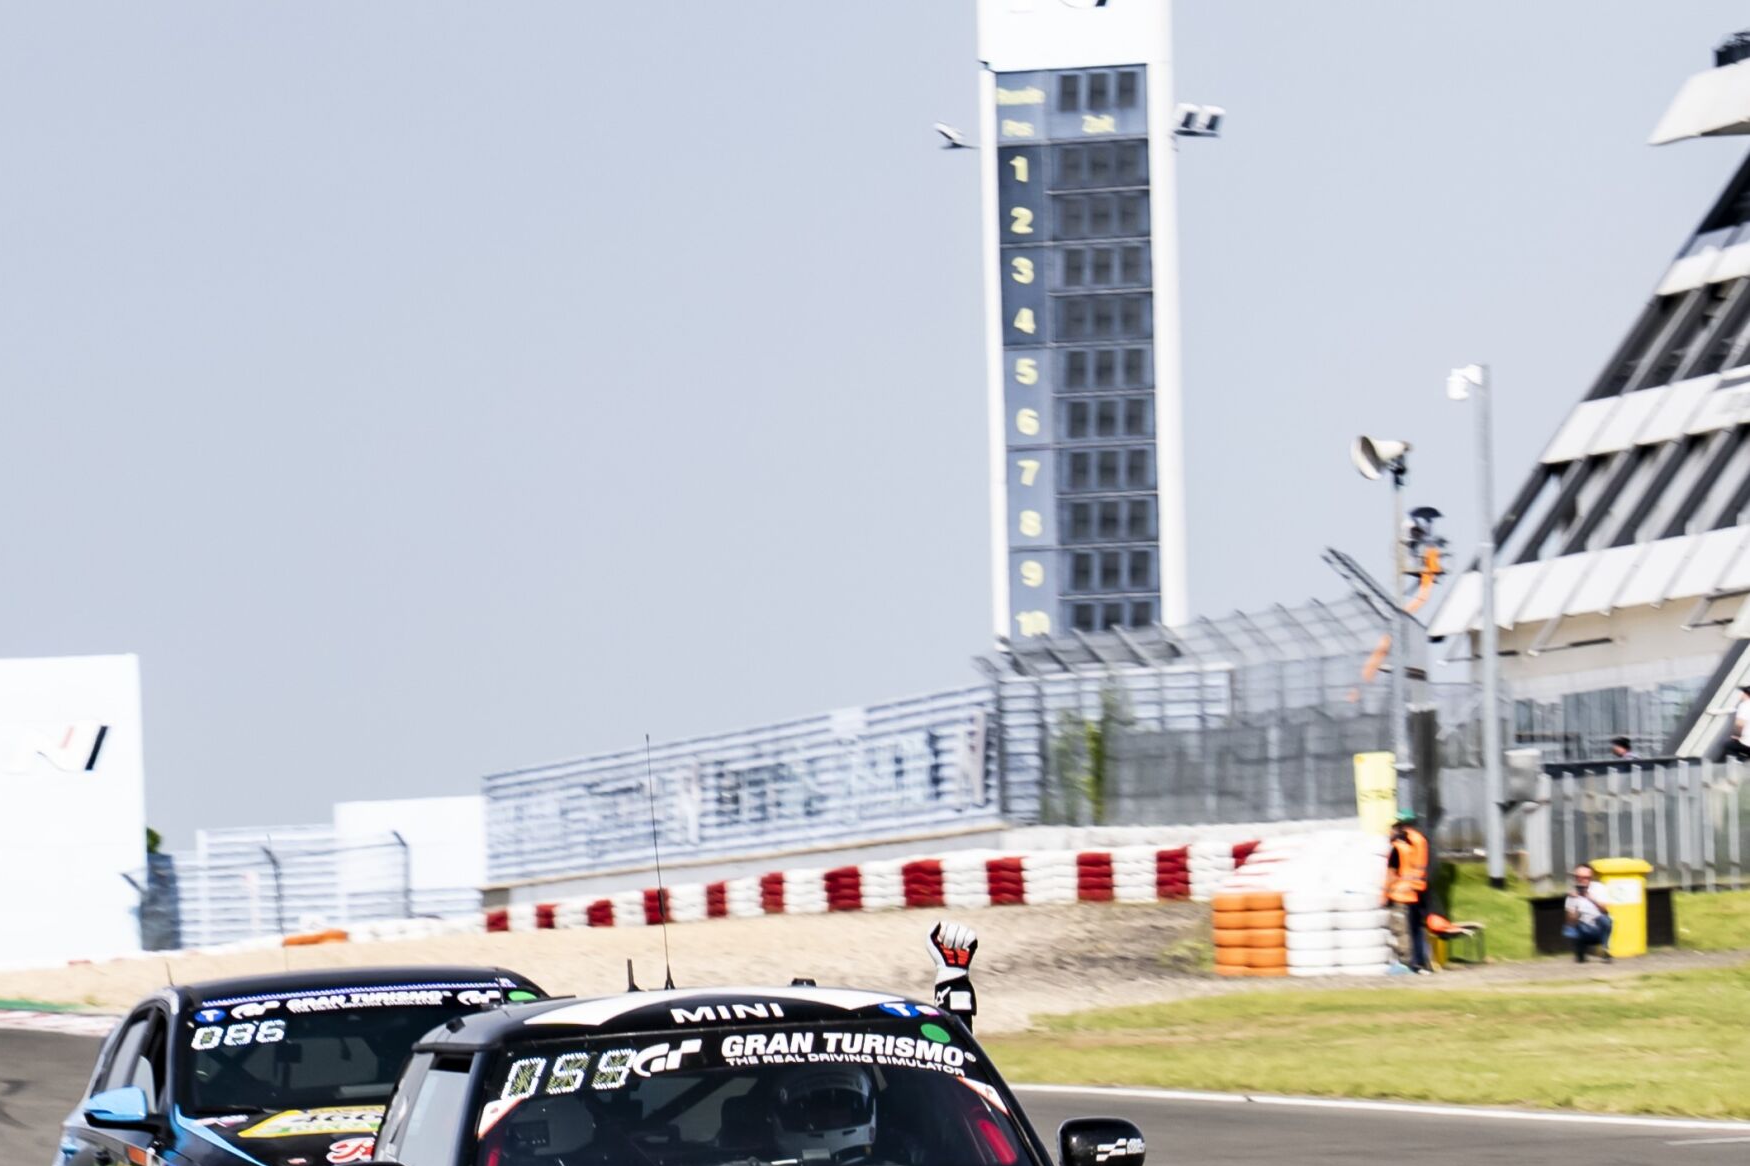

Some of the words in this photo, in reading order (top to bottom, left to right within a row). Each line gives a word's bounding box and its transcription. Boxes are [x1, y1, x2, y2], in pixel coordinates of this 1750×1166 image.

[1009, 155, 1030, 183] 1
[1010, 206, 1034, 234] 2
[1011, 256, 1035, 284] 3
[1013, 307, 1036, 334] 4
[1015, 358, 1039, 385] 5
[1015, 407, 1040, 436] 6
[1016, 459, 1041, 487] 7
[1018, 509, 1043, 538] 8
[1019, 560, 1045, 588] 9
[670, 1002, 786, 1024] MINI
[721, 1032, 814, 1058] GRAN
[725, 1057, 759, 1067] THE
[763, 1054, 805, 1064] REAL
[807, 1053, 874, 1064] DRIVING
[876, 1056, 966, 1077] SIMULATOR
